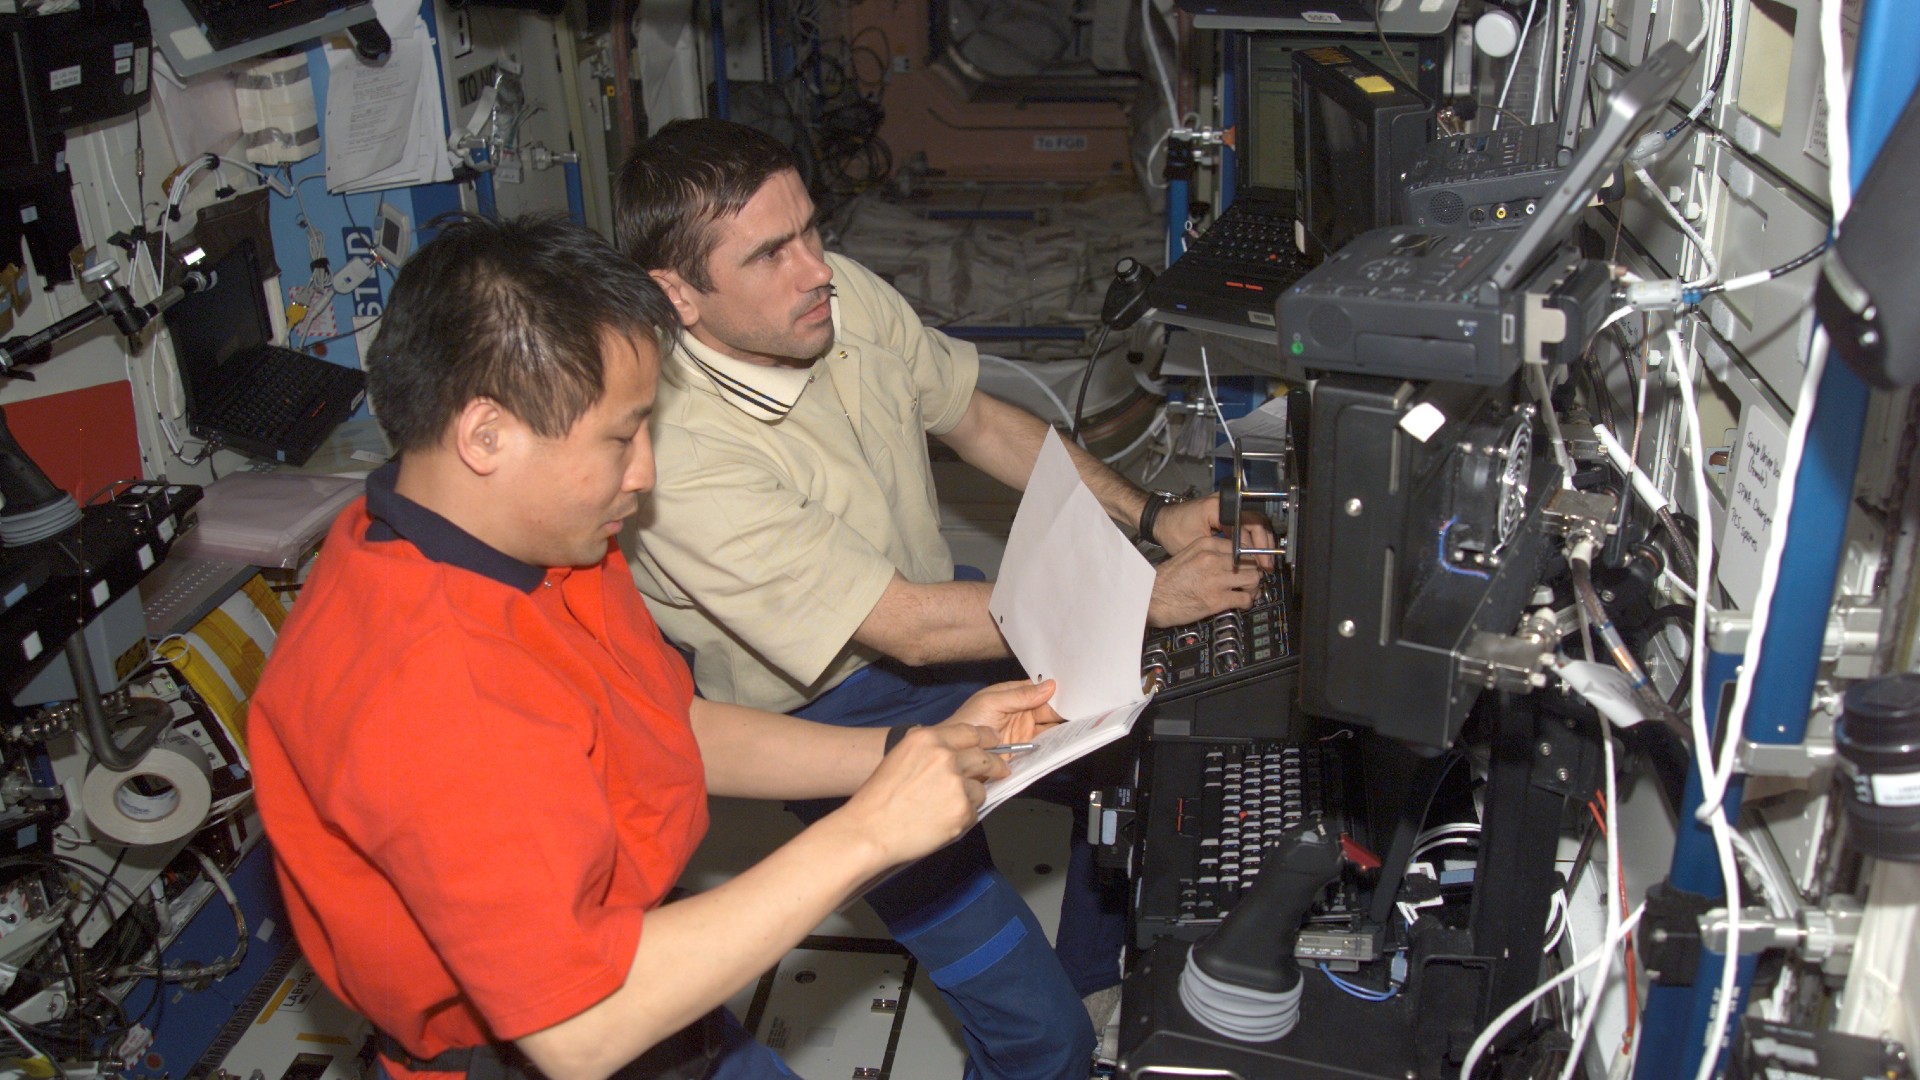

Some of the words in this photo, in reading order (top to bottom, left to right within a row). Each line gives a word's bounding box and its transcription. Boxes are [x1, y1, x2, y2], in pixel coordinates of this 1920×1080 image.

[458, 73, 478, 106] TO
[1036, 137, 1053, 149] To
[346, 231, 383, 316] STD
